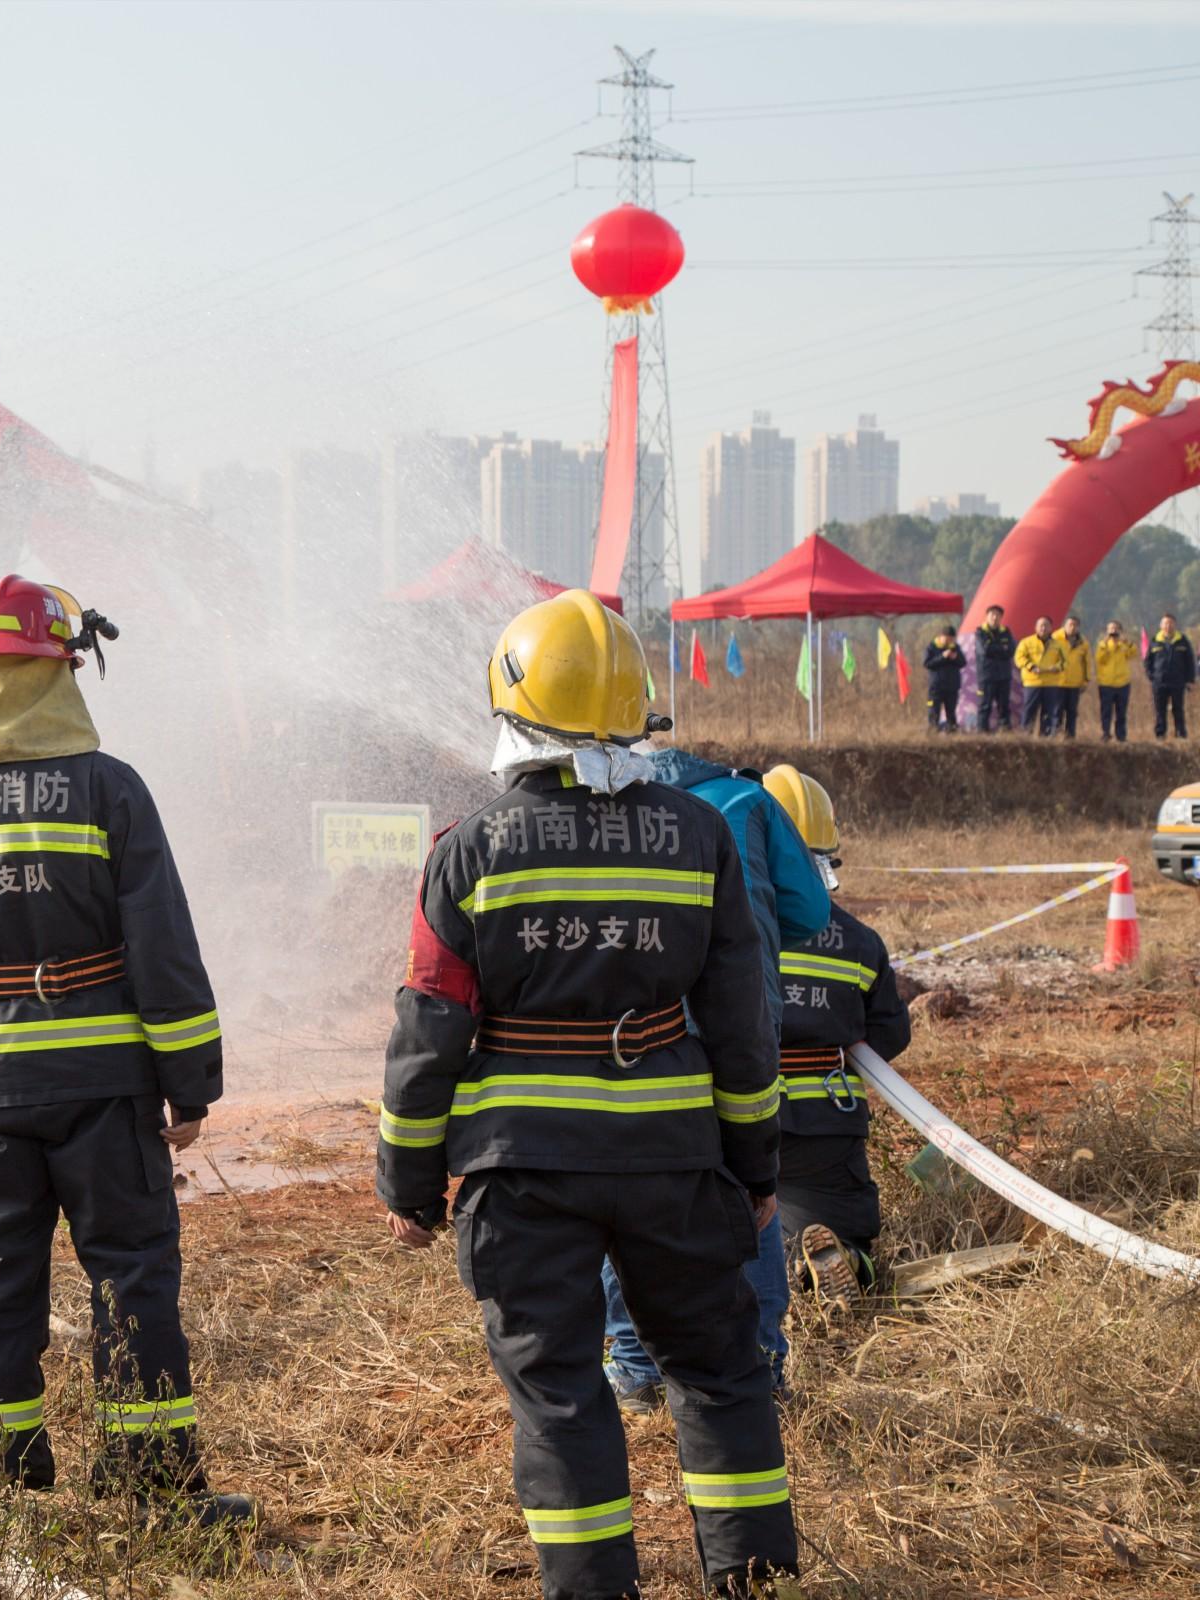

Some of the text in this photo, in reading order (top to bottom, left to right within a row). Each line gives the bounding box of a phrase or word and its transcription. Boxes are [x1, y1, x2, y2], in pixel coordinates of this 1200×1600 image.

[327, 829, 416, 853] 天然气抢修
[482, 801, 680, 858] 湖南消防
[517, 916, 665, 953] 长沙支队
[804, 920, 845, 950] 防
[784, 983, 831, 1010] 支队
